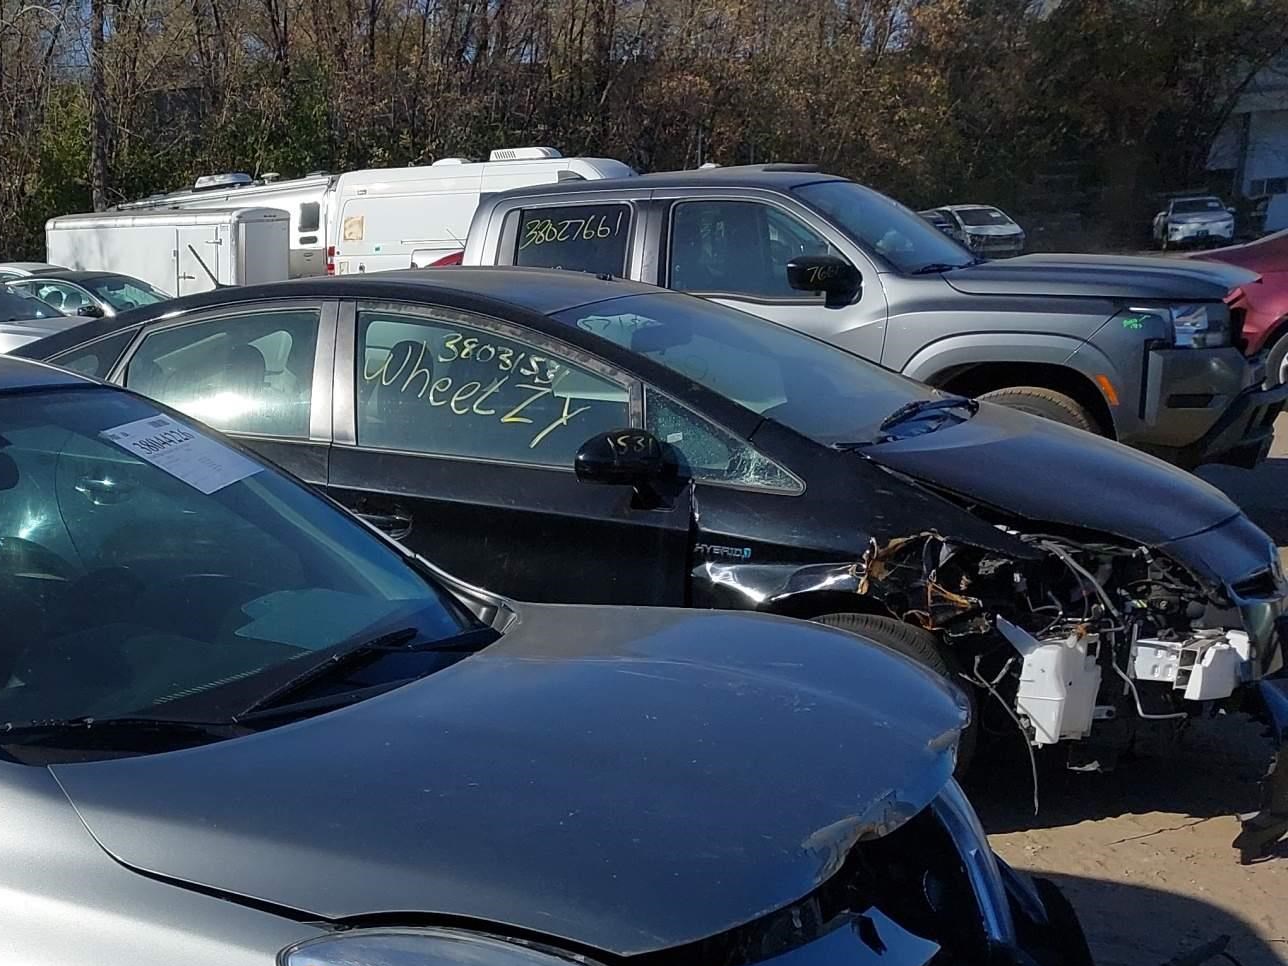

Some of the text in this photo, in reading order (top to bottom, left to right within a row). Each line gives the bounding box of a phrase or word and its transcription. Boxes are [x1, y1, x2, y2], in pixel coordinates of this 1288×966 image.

[520, 211, 623, 250] 38027661
[132, 429, 197, 455] 38044226
[606, 434, 653, 456] 1531
